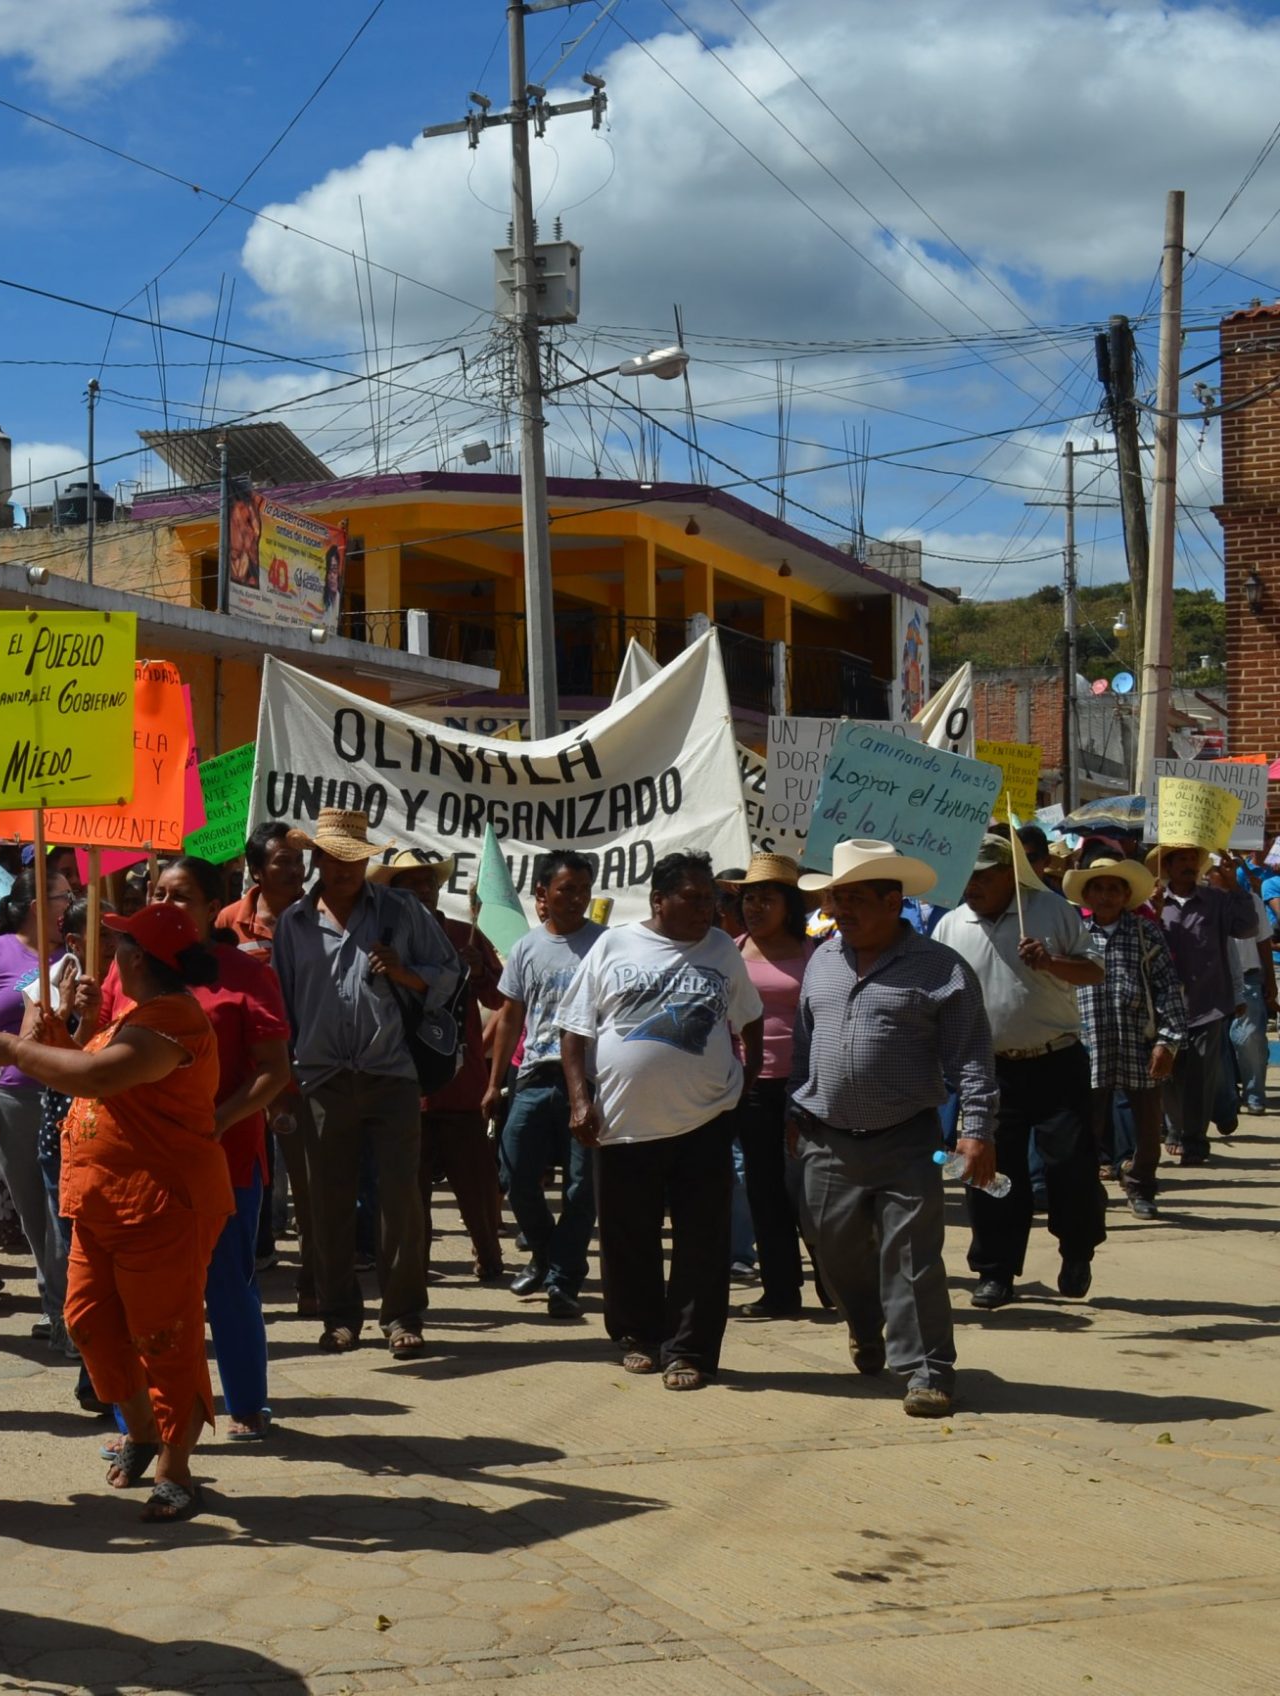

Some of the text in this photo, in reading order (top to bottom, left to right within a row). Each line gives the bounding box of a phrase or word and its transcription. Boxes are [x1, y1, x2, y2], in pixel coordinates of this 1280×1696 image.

[8, 634, 23, 655] EL
[25, 627, 104, 676] PUEBLO
[40, 685, 51, 702] EL
[58, 679, 128, 714] GOBIERNO
[333, 708, 603, 785] OLINALÁ
[771, 720, 798, 745] UN
[152, 758, 164, 785] Y
[830, 758, 901, 804] Lograr
[908, 784, 935, 808] el
[949, 760, 997, 792] hasta
[1154, 760, 1177, 777] EN
[266, 771, 388, 829] UNIDO
[400, 788, 429, 832] Y
[437, 766, 683, 841] ORGANIZADO
[823, 799, 847, 826] de
[856, 801, 876, 834] la
[883, 813, 953, 858] Justicia
